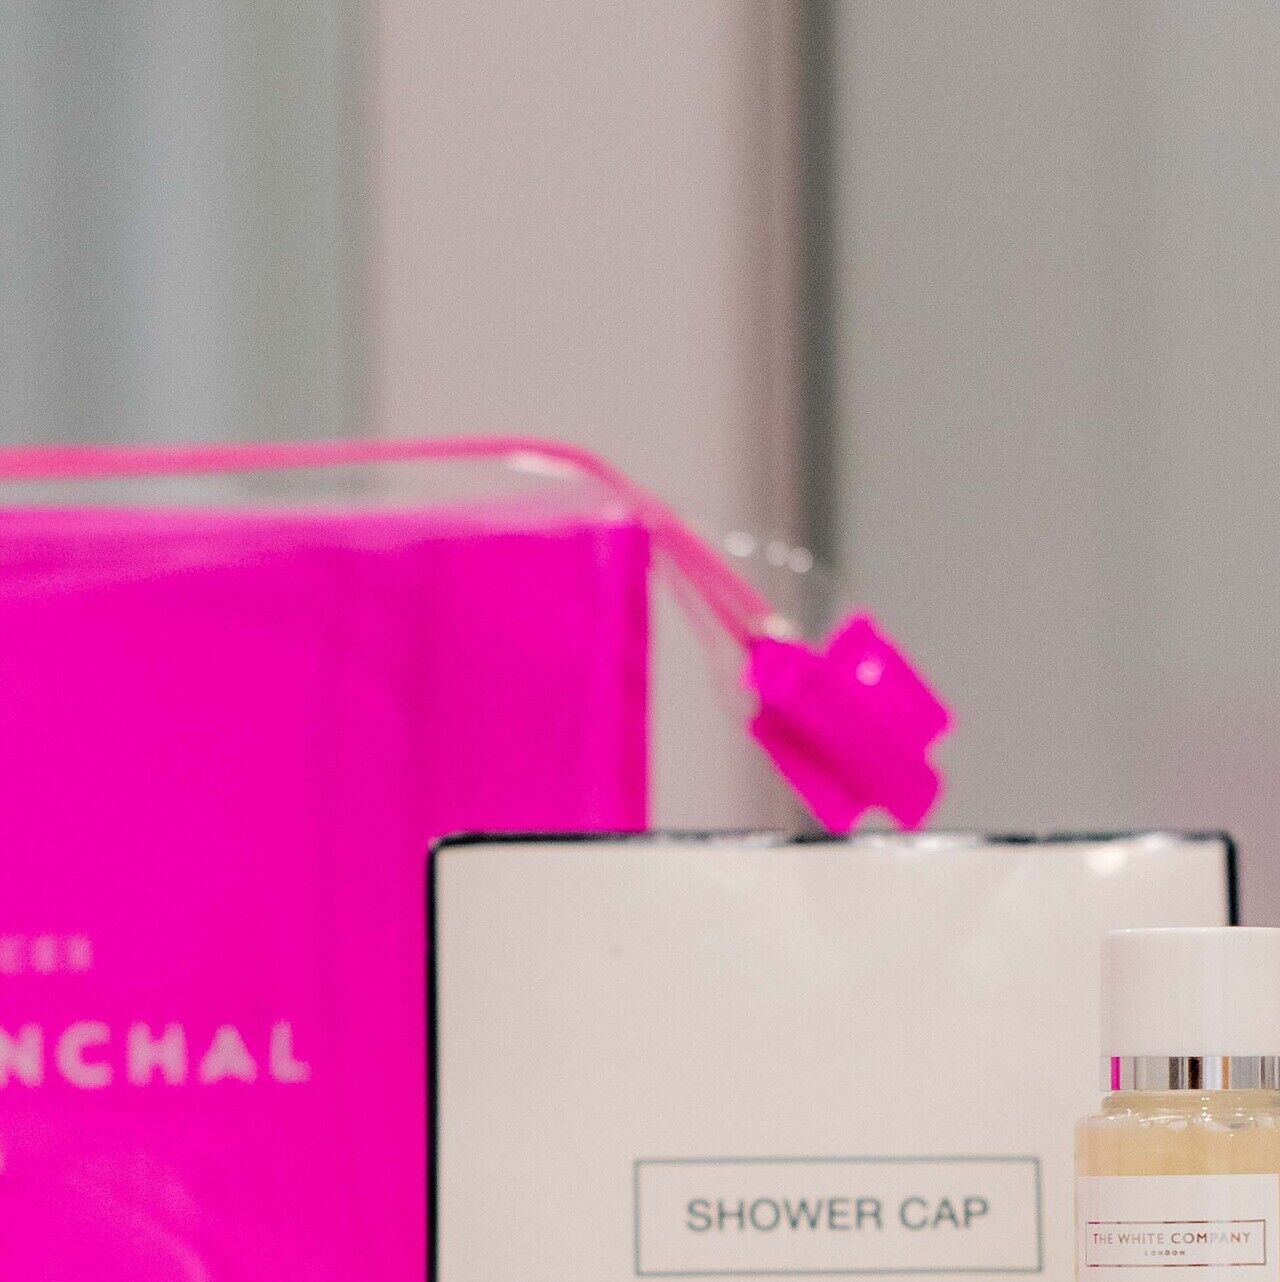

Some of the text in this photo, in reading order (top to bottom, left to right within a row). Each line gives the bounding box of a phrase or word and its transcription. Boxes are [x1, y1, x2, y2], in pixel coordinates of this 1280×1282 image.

[686, 1195, 989, 1232] SHOWER CAP
[1092, 1231, 1251, 1245] THE WHITE COMPANY
